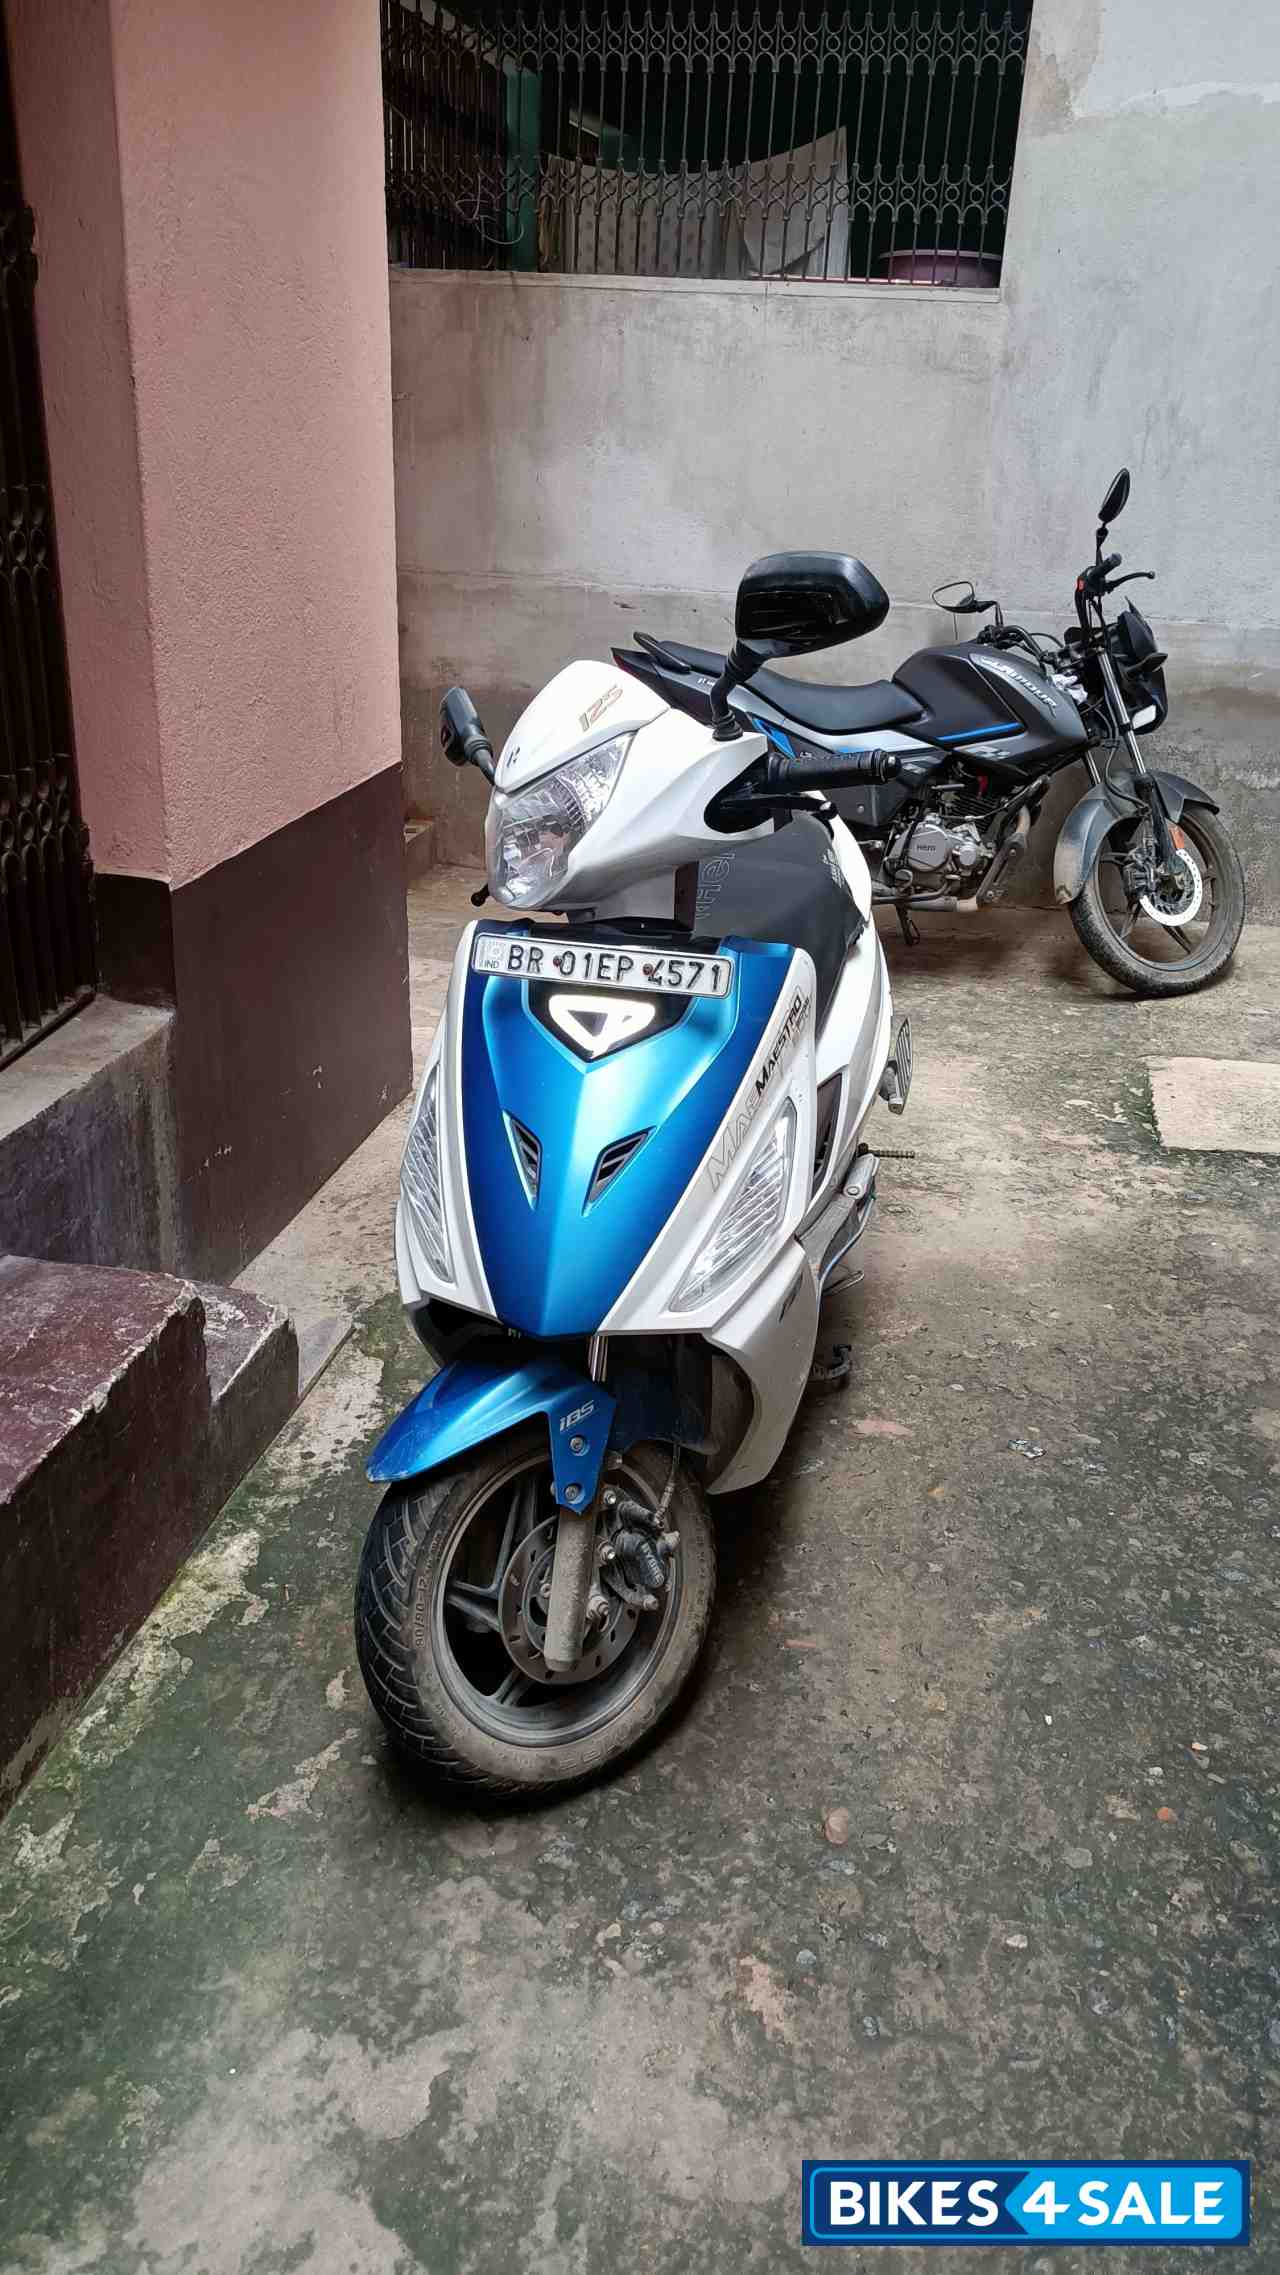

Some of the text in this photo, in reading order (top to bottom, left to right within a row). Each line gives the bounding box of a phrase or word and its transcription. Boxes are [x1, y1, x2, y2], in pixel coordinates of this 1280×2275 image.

[578, 684, 623, 732] 125
[507, 944, 721, 992] BR 01EP 4571
[755, 995, 803, 1097] MAESTRO
